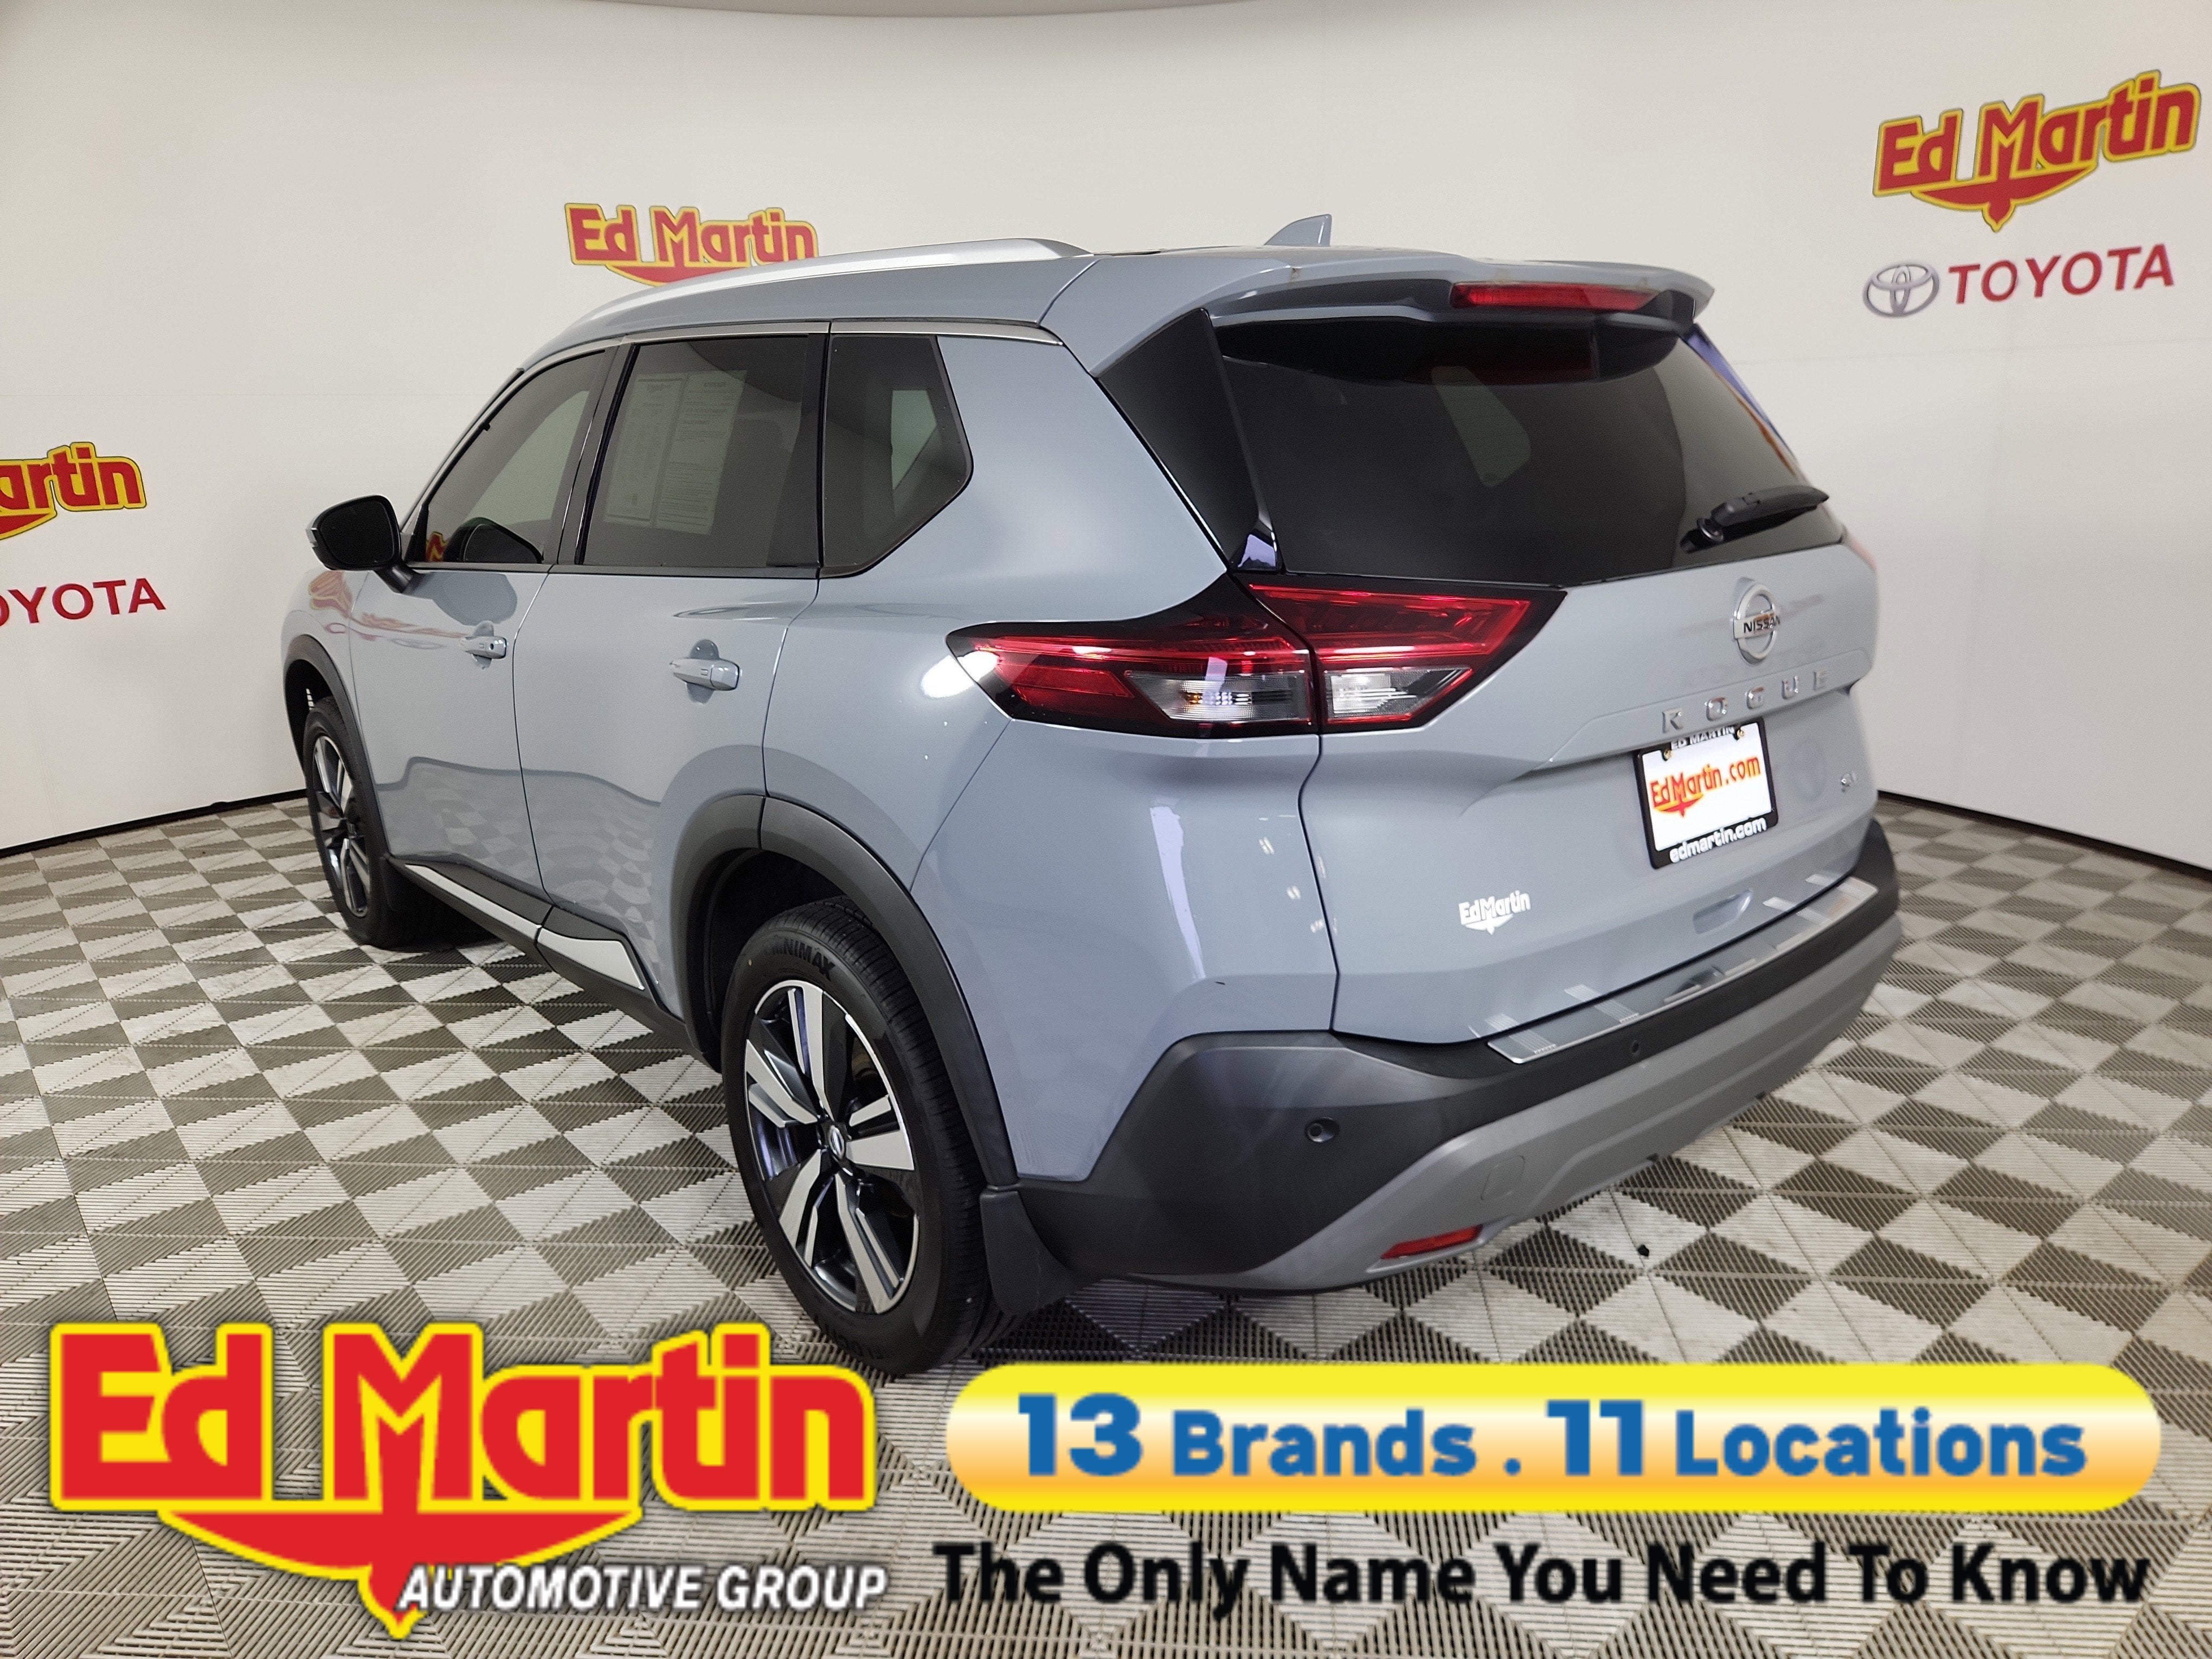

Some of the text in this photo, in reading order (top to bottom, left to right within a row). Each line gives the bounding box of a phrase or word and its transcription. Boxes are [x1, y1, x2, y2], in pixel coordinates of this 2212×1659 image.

[1874, 71, 2201, 195] Ed Martin
[566, 204, 819, 264] Ed Martin
[1948, 243, 2175, 305] TOYOTA
[0, 577, 166, 627] YOTA
[1743, 614, 1780, 634] NISSAN
[1662, 670, 1828, 734] ROGUE
[1671, 726, 1735, 750] ED MARTIN
[1650, 756, 1761, 808] EdMartin.com
[1669, 817, 1767, 863] edmartin.com
